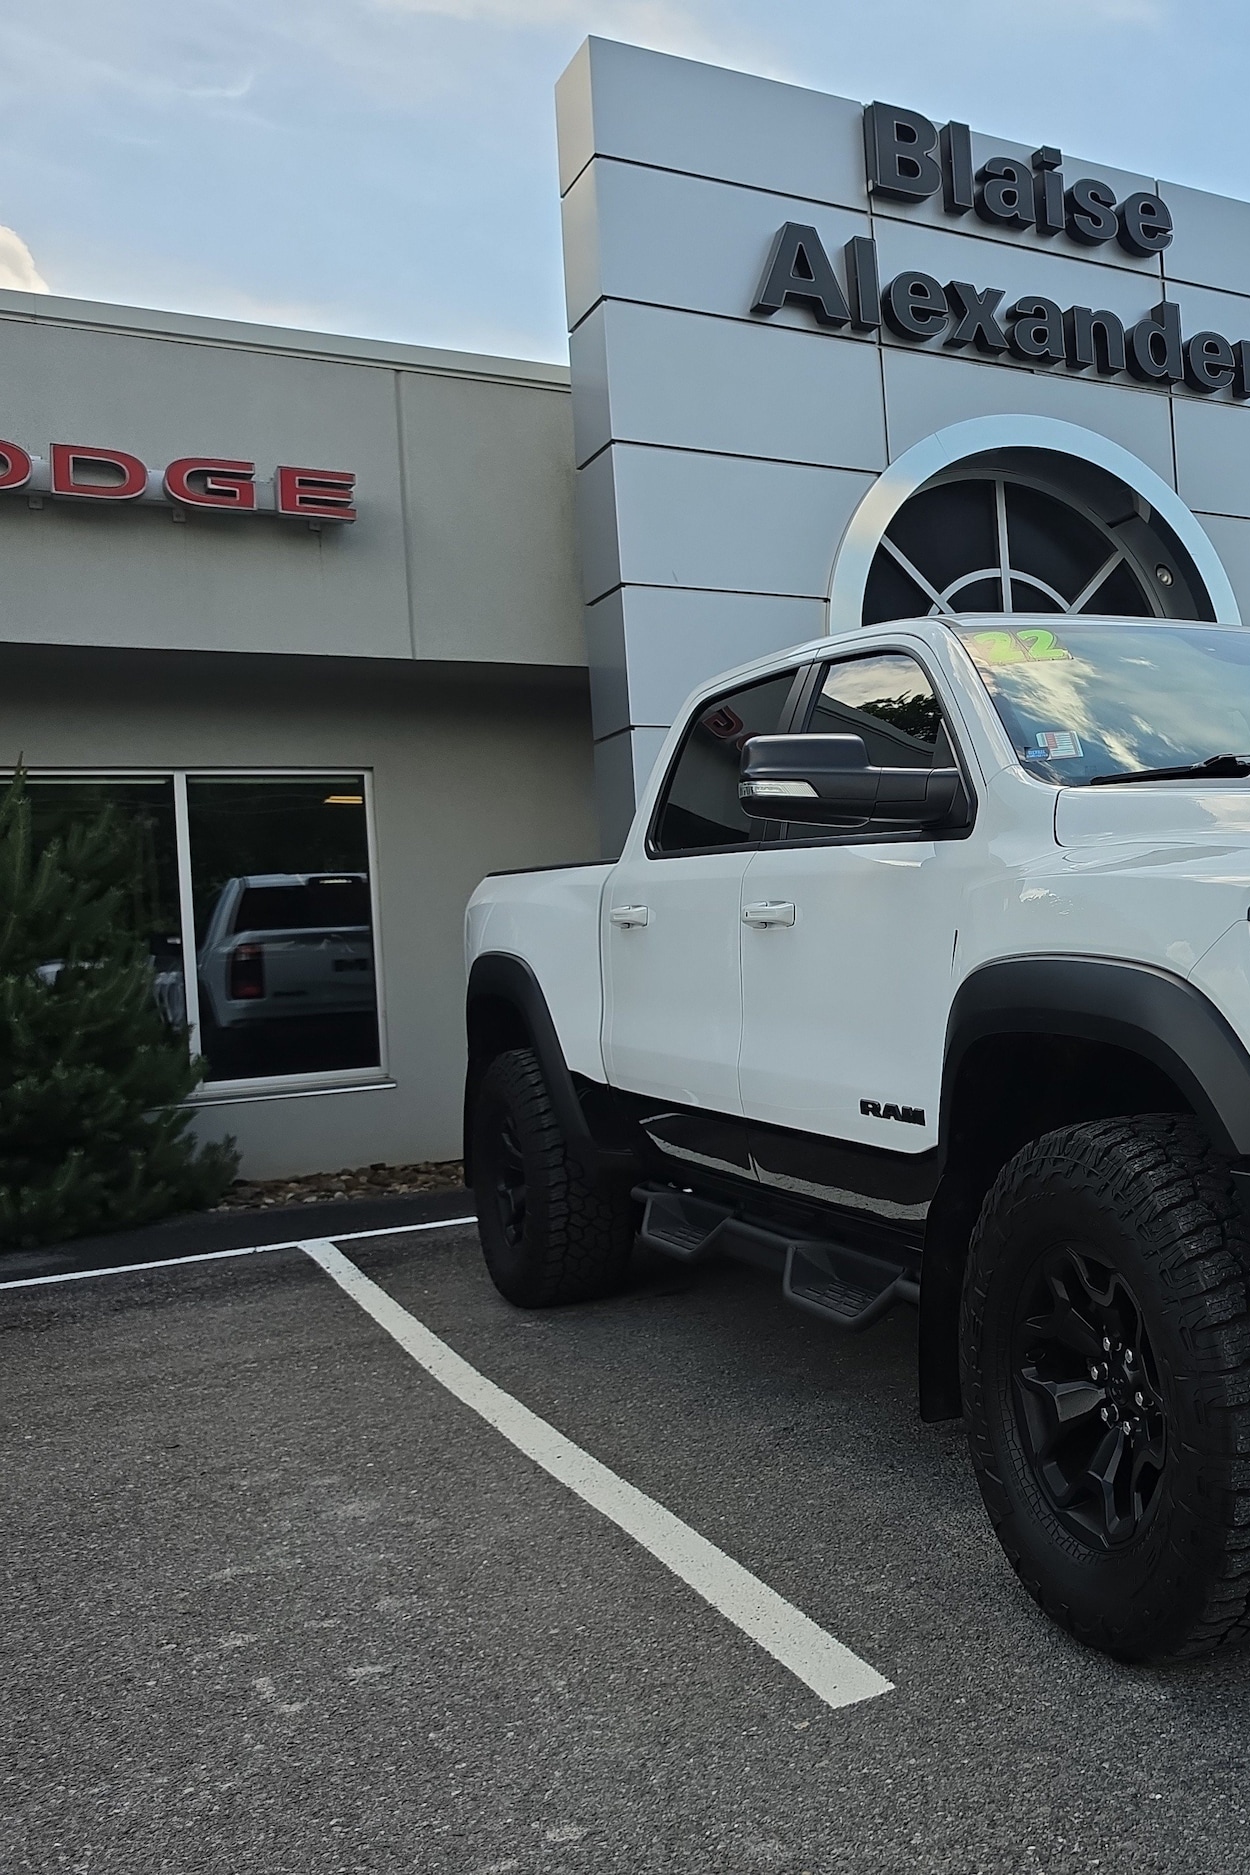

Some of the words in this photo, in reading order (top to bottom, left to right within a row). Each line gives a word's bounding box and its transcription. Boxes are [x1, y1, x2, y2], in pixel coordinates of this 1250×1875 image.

[864, 101, 1173, 258] Blaise
[973, 629, 1067, 664] 22
[859, 1098, 926, 1127] RAM
